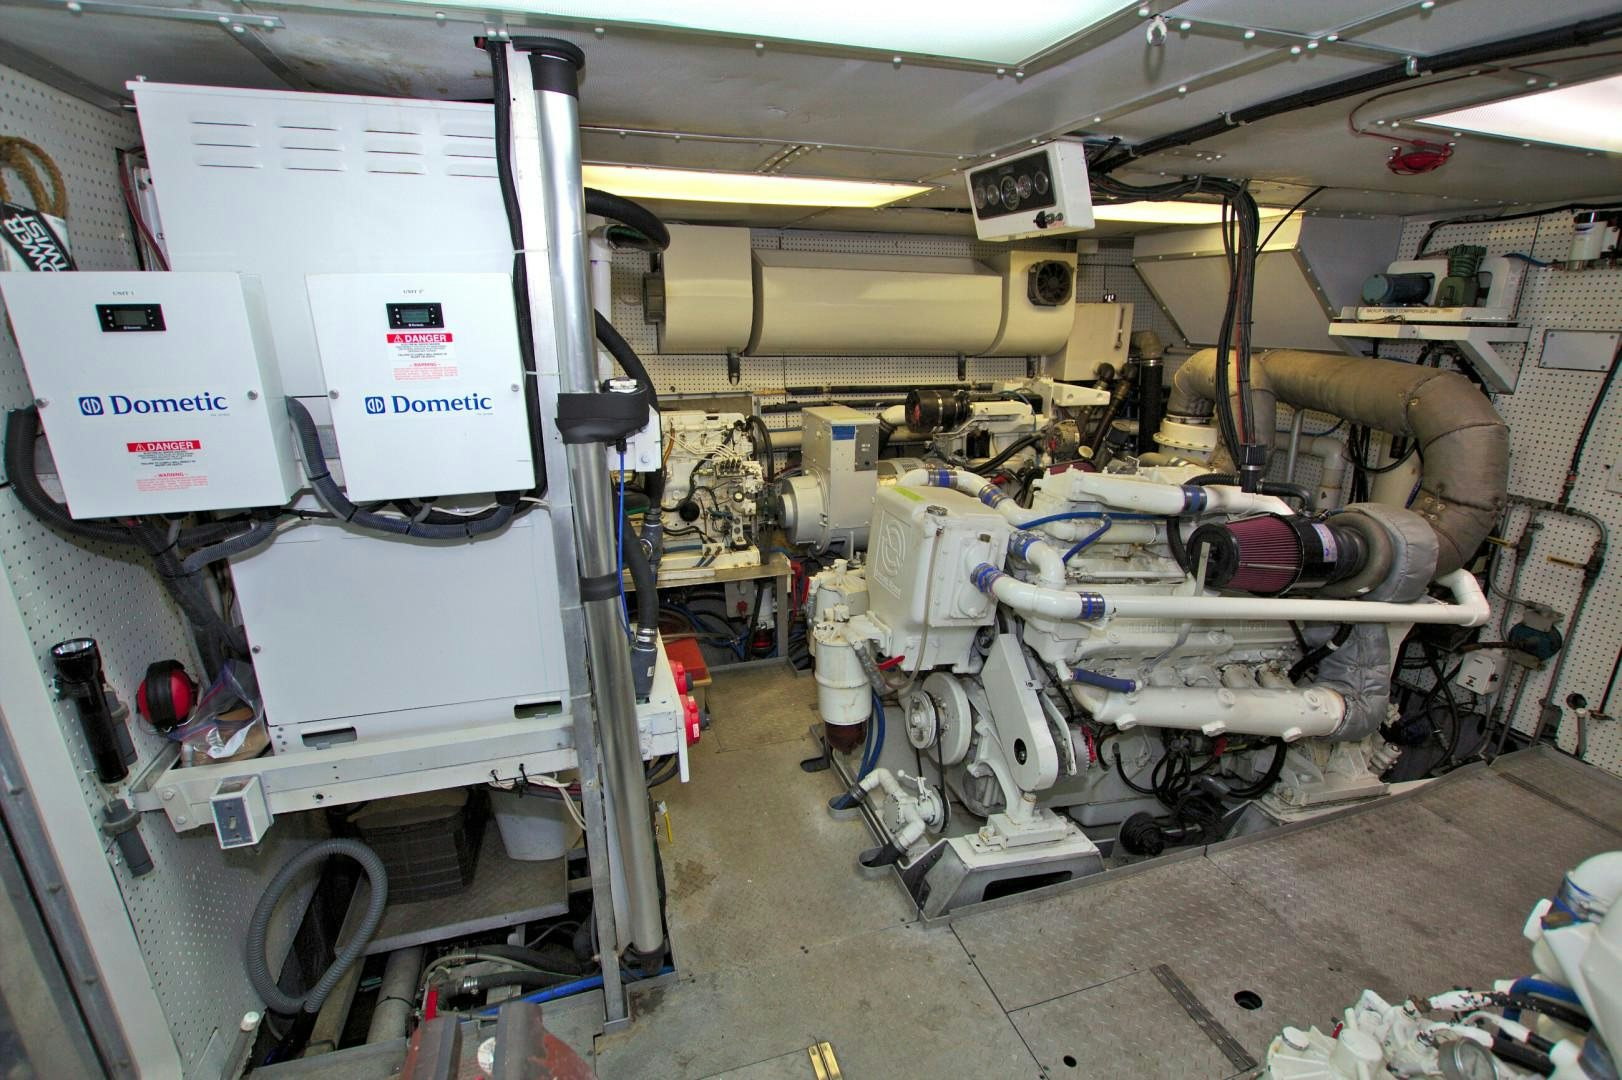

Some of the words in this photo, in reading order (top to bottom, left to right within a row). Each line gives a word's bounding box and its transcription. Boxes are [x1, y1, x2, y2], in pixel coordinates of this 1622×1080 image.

[3, 217, 57, 271] OWER
[14, 212, 67, 271] TWIST
[404, 334, 447, 342] DANGER
[108, 392, 228, 415] Dometic
[391, 393, 493, 414] Dometic
[147, 441, 194, 451] DANGER
